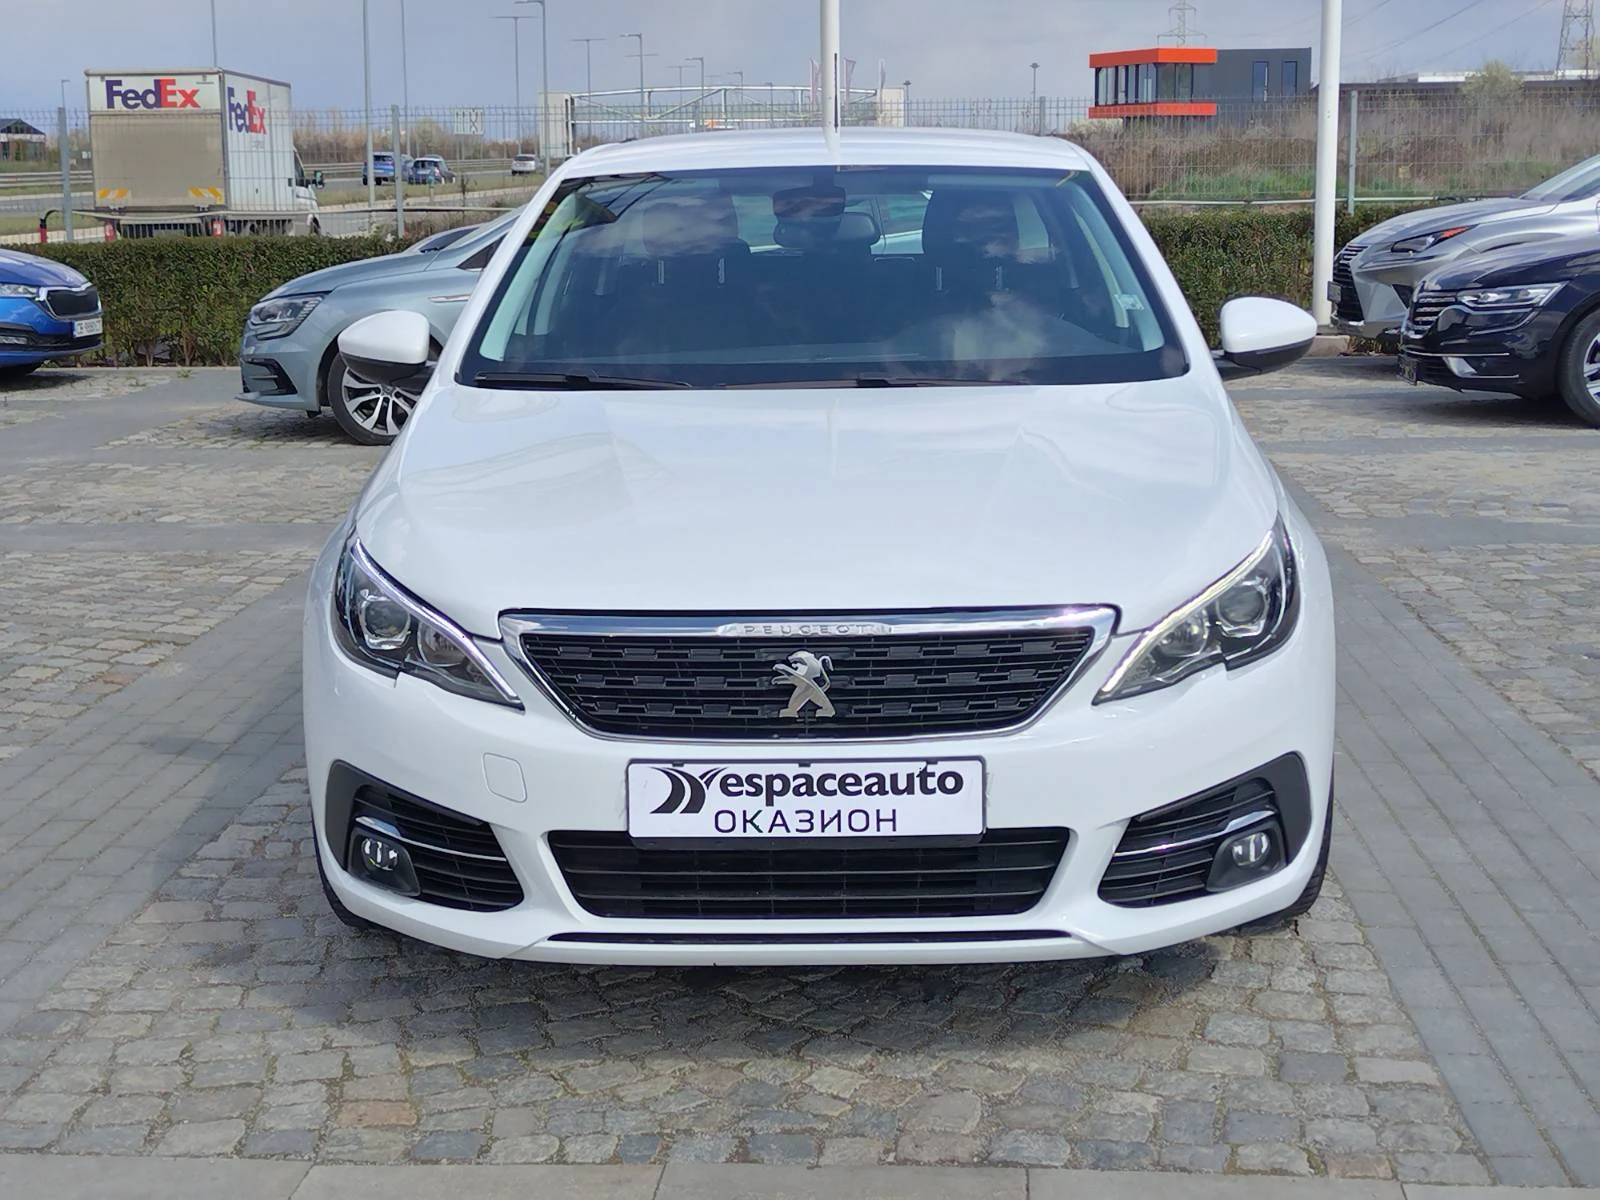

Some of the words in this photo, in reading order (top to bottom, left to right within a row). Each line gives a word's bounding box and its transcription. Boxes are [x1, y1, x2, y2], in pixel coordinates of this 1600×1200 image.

[105, 79, 200, 109] FedEx
[227, 86, 267, 135] FedEx
[744, 624, 870, 634] PEUGEOT
[719, 763, 964, 806] espaceauto
[714, 808, 897, 834] ОКАЗИОН
